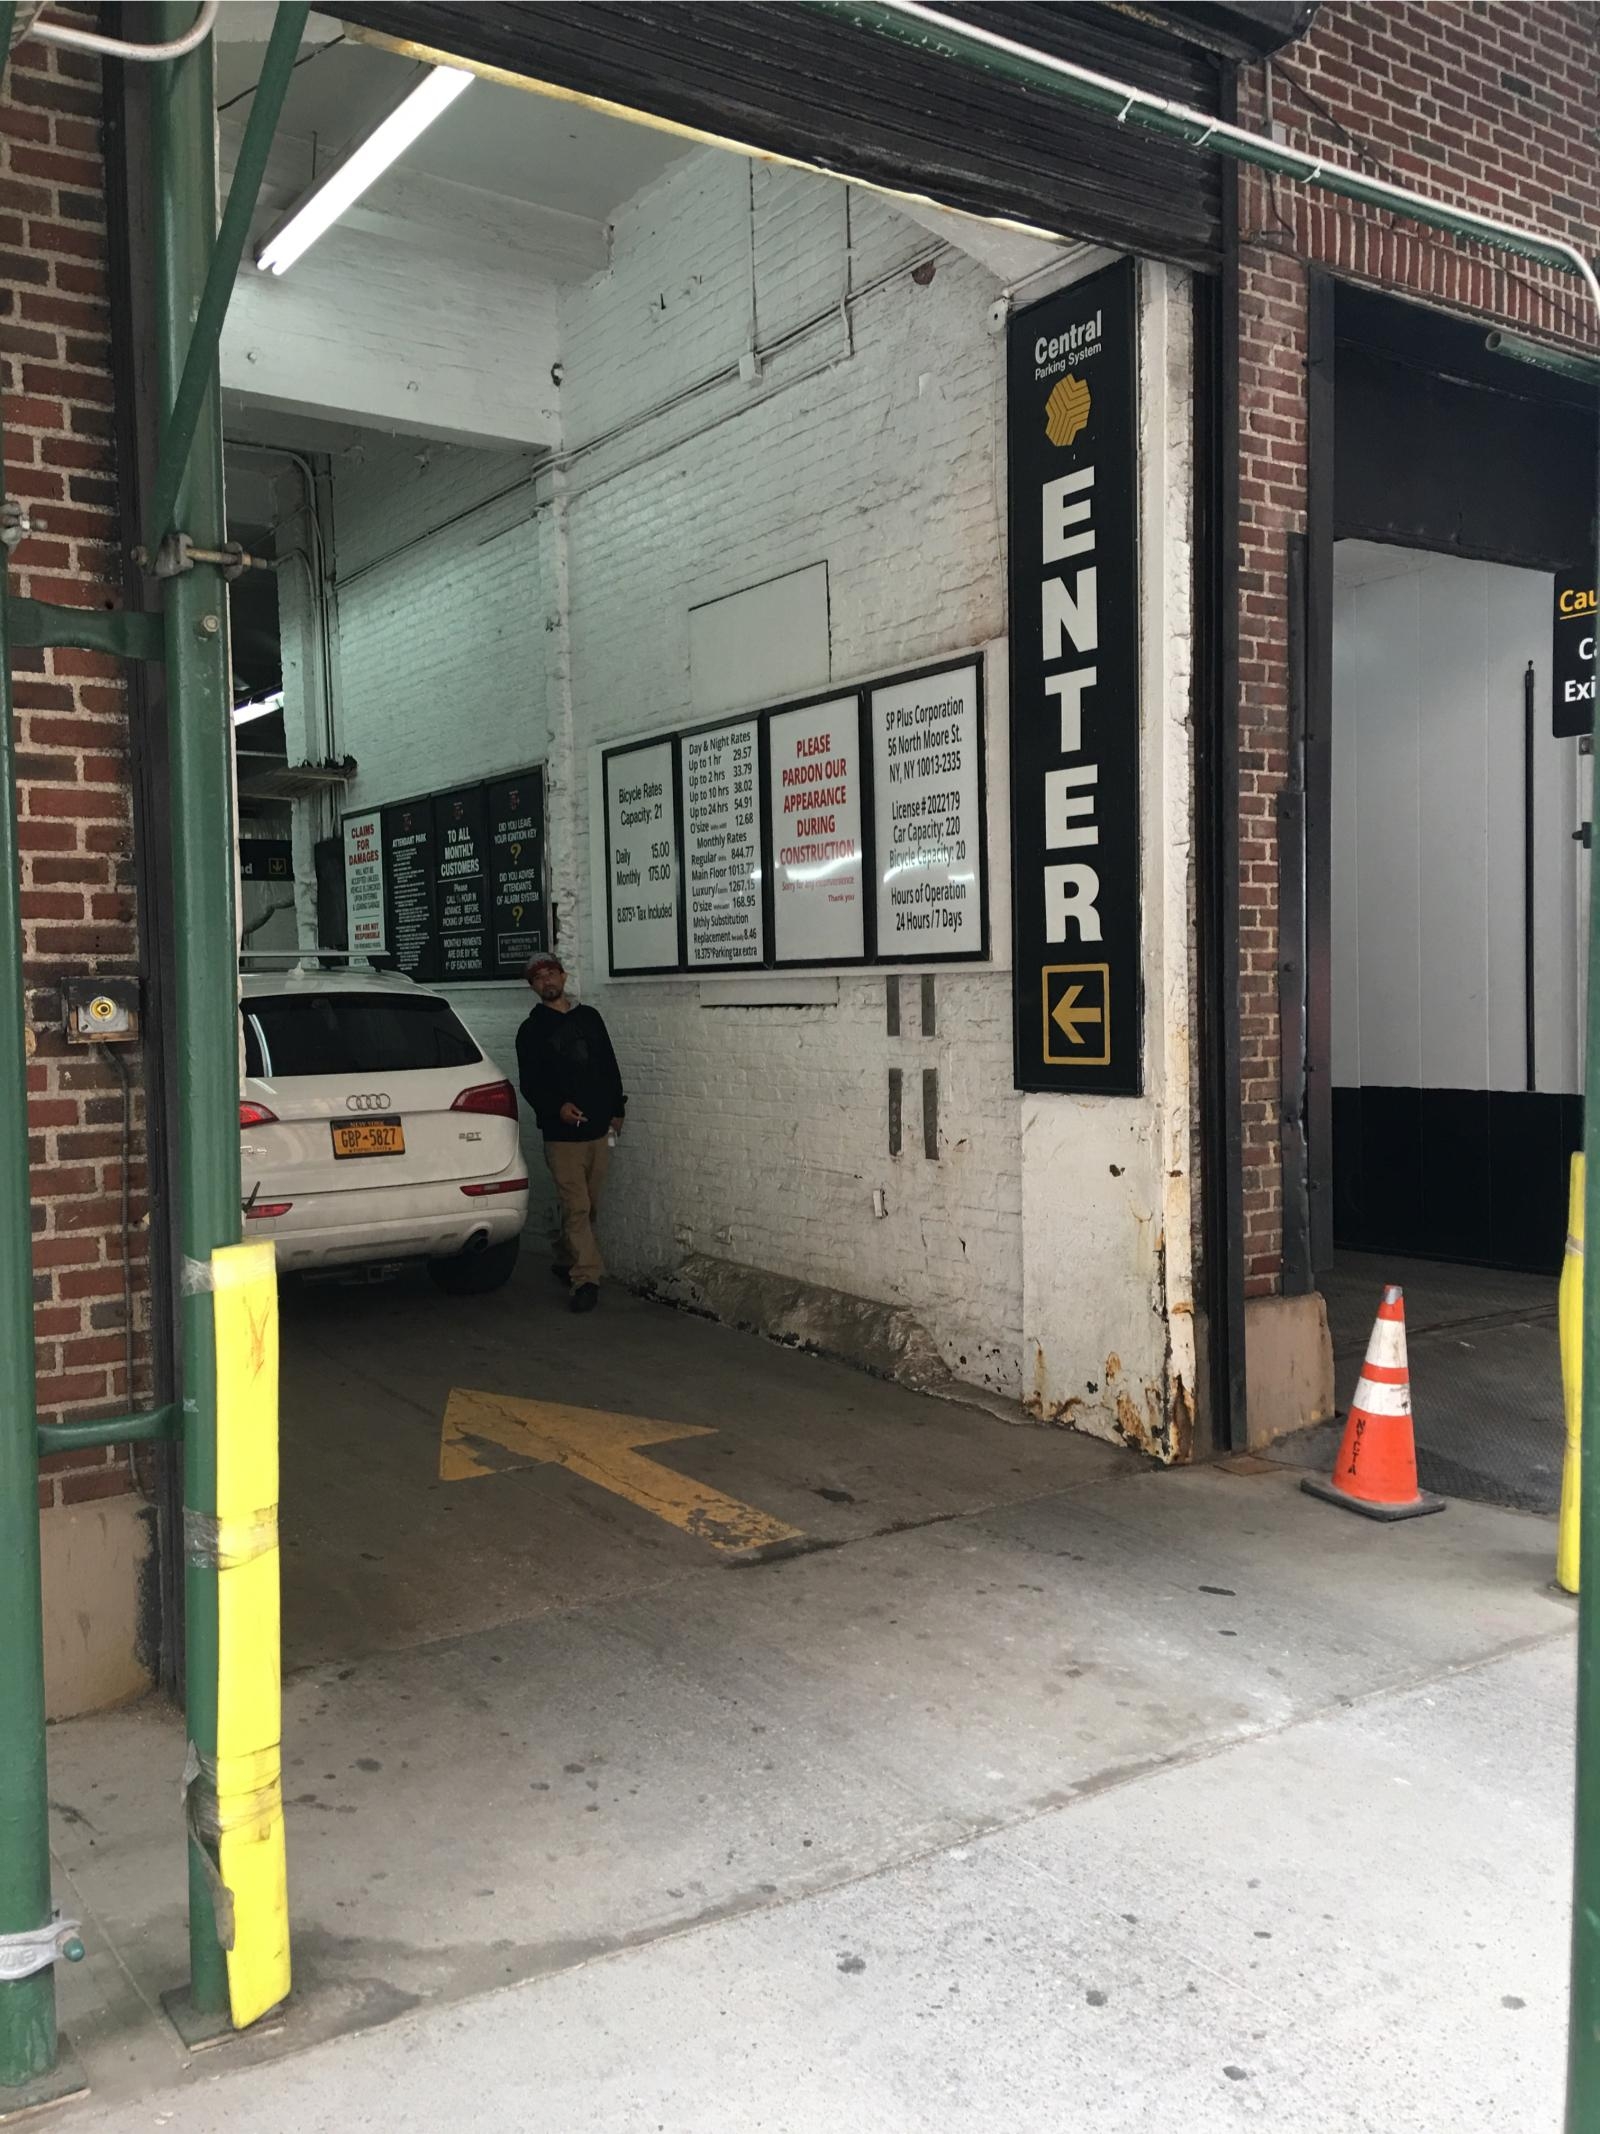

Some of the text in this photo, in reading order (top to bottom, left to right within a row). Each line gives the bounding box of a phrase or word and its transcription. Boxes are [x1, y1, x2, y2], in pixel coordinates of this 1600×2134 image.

[1035, 309, 1102, 365] Central
[1035, 343, 1102, 381] Parking System
[1579, 637, 1597, 660] C
[886, 696, 964, 732] SP Plus Corporation
[1041, 465, 1103, 943] ENTER
[689, 731, 751, 757] Day & Night Rates
[796, 734, 831, 759] PLEASE
[888, 724, 962, 757] 56 North Moore St.
[689, 760, 698, 773] Up
[699, 759, 706, 769] to
[713, 754, 721, 765] hr
[782, 758, 847, 787] PARDON OUR
[890, 751, 962, 784] NY, NY 10013-2335
[689, 776, 699, 789] Up
[699, 774, 707, 784] to
[713, 770, 726, 782] hrs
[733, 762, 753, 778] 33.79
[618, 783, 663, 805] Bicycle Rates
[690, 779, 753, 804] Up to 10 hrs 38.02
[783, 785, 847, 814] APPEARANCE
[621, 804, 663, 828] Capacity: 21
[690, 795, 753, 820] Up to 24 hrs 54.91
[892, 799, 920, 821] License
[351, 823, 375, 839] CLAIMS
[507, 820, 518, 831] YOU
[518, 817, 532, 829] LEAVE
[735, 812, 754, 827] 12.68
[796, 814, 836, 838] DURING
[894, 816, 960, 846] Car Capacity: 220
[356, 838, 370, 851] FOR
[447, 826, 471, 844] TO ALL
[697, 832, 747, 849] Monthly Rates
[348, 850, 379, 866] DAMAGES
[444, 842, 474, 861] MONTHLY
[510, 842, 522, 865] ?
[615, 841, 670, 866] Daily 15.00
[691, 851, 717, 868] Regular
[731, 846, 755, 860] 844.77
[780, 838, 855, 866] CONSTRUCTION
[890, 840, 966, 872] Bicycle Capacity: 20
[441, 857, 480, 877] CUSTOMERS
[508, 871, 518, 881] YOU
[616, 864, 671, 887] Monthly 175.00
[692, 869, 709, 881] Main
[709, 867, 728, 879] Floor
[520, 891, 539, 903] SYSTEM
[729, 879, 756, 893] 1267.15
[891, 879, 966, 908] Hours of Operation
[732, 895, 756, 909] 168.95
[828, 894, 855, 904] Thank you
[512, 904, 524, 927] ?
[636, 905, 647, 921] Tax
[648, 902, 673, 920] Included
[710, 913, 749, 927] Substitution
[896, 912, 905, 931] 24
[907, 911, 930, 930] Hours
[942, 908, 963, 933] Days
[693, 930, 731, 946] Replacement
[743, 928, 757, 941] 8.46
[712, 946, 733, 961] Parking
[742, 946, 758, 957] extra
